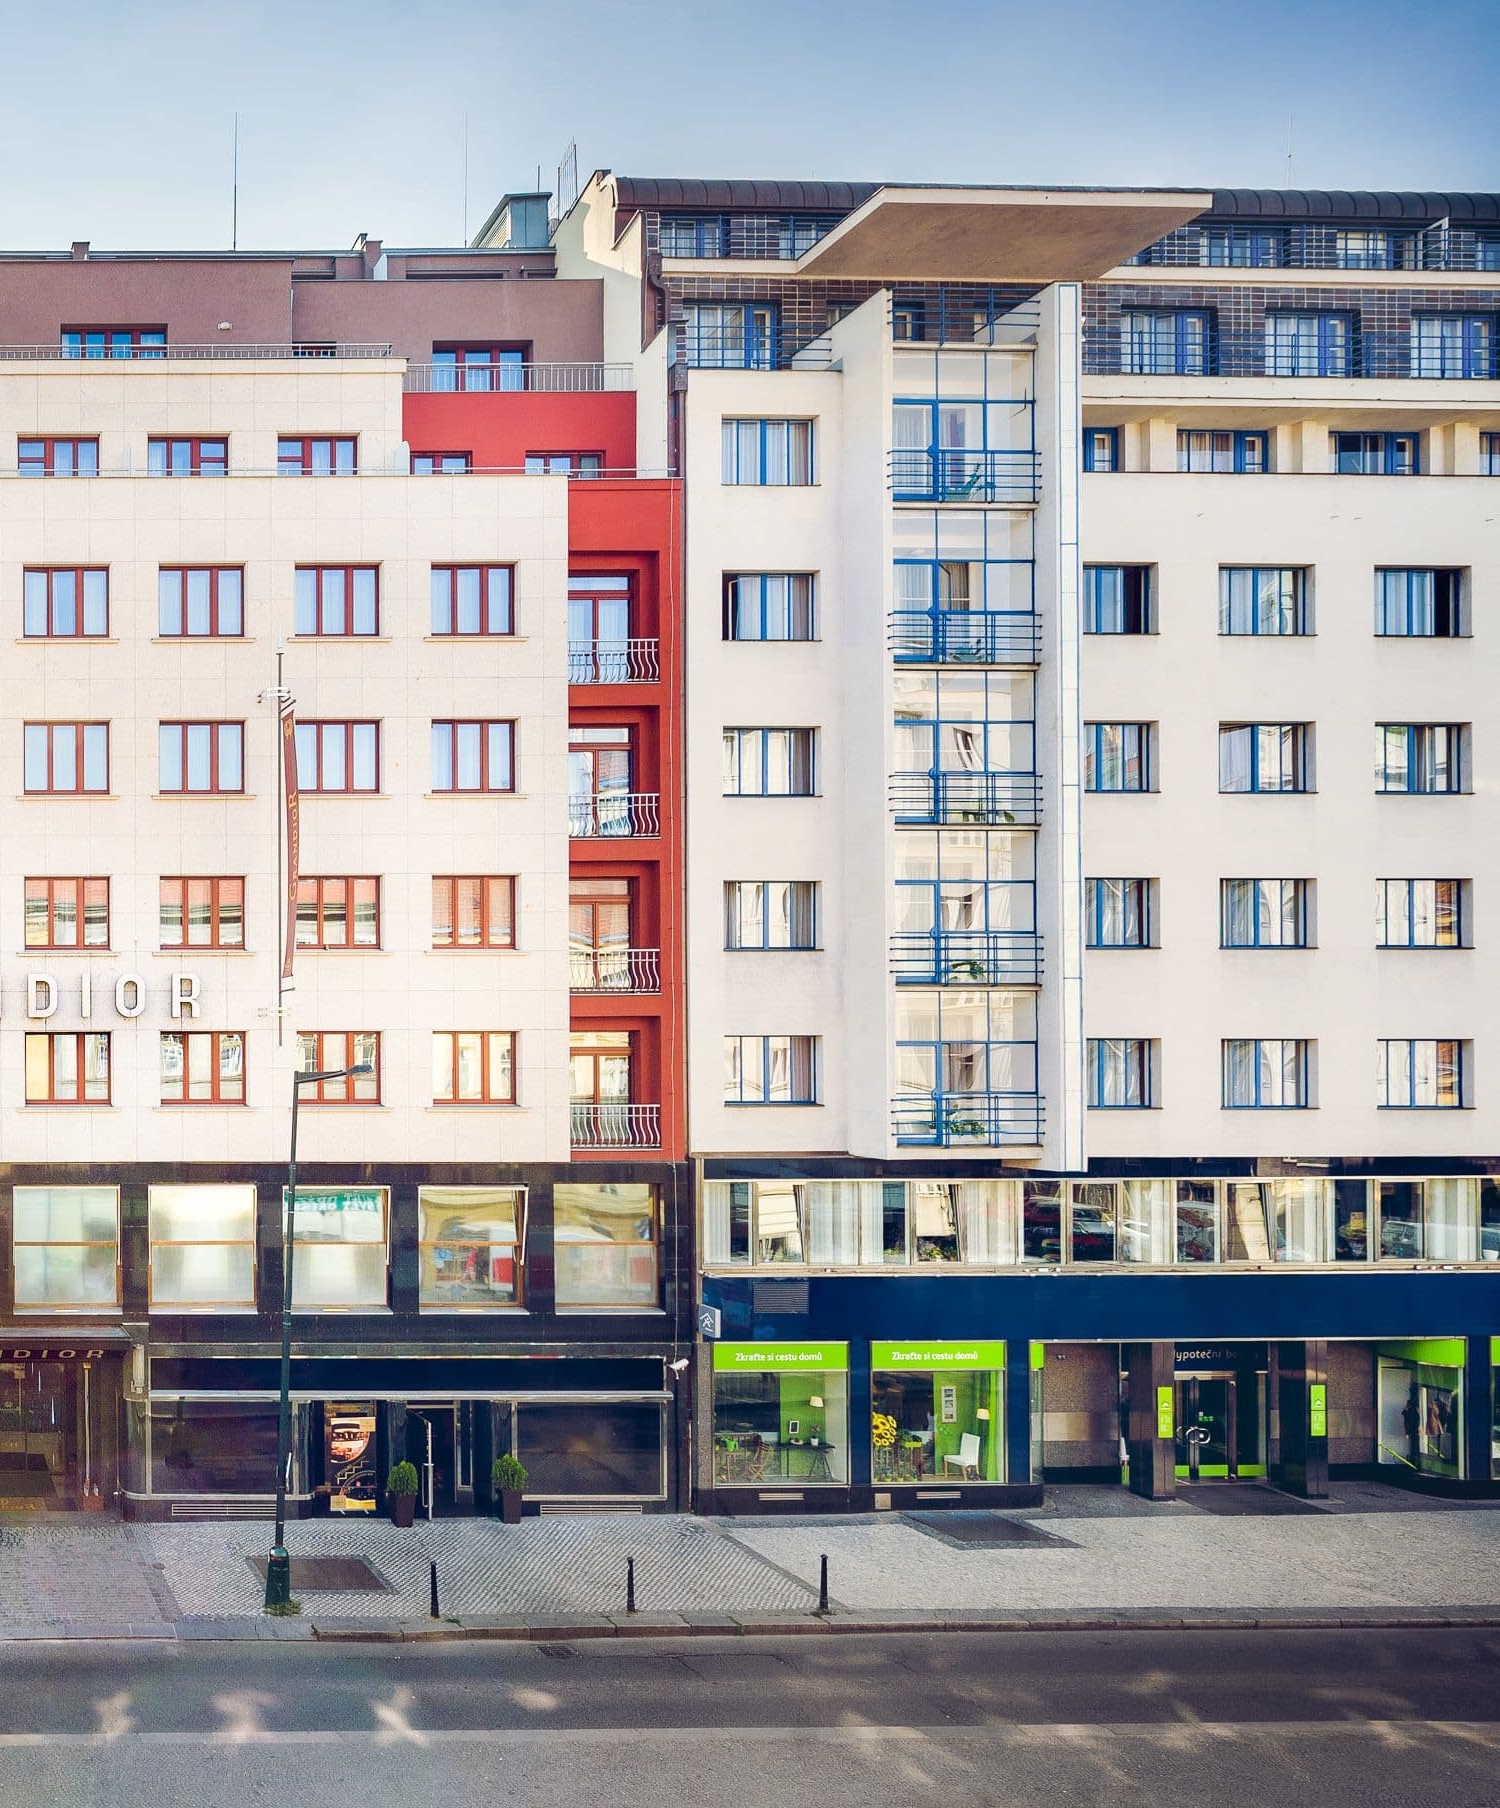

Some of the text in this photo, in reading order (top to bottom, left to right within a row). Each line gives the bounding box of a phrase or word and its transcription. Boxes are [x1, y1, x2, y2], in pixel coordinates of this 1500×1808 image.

[735, 1352, 823, 1361] Zkraťte si cestu domů
[891, 1351, 978, 1360] Zkraťte si cestu domů
[1173, 1349, 1220, 1361] ypoteční
